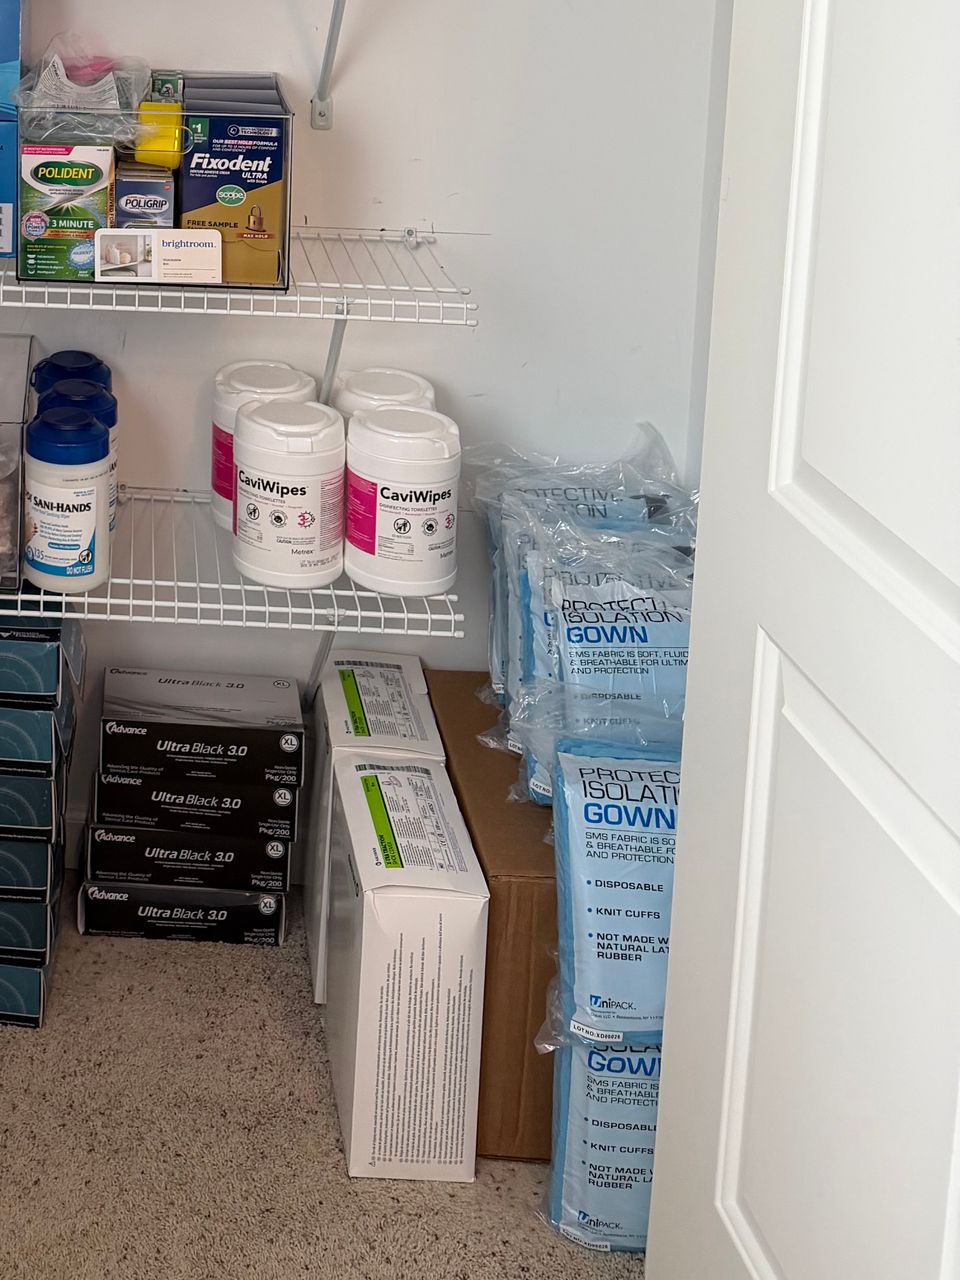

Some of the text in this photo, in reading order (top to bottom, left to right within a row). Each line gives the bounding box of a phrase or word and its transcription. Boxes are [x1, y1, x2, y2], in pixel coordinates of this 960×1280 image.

[190, 153, 272, 171] Fixodent
[38, 166, 95, 179] POLIDENT
[124, 198, 167, 210] POLIGRIP
[58, 220, 94, 229] MINUTE
[208, 220, 239, 229] SAMPLE
[162, 239, 213, 249] brightroom
[238, 470, 307, 498] CaviWipes
[380, 487, 452, 505] CaviWipes
[33, 497, 92, 513] SANI-HANDS
[562, 610, 683, 624] ISOLATION
[566, 625, 649, 644] GOWN
[594, 667, 649, 675] PROTECTION
[106, 721, 148, 735] Advance
[156, 740, 248, 756] Ultra Black 3.0
[102, 774, 143, 786] Advance
[151, 791, 242, 809] Ultra Black 3.0
[584, 803, 675, 829] GOWN
[94, 829, 136, 843] Advance
[585, 832, 648, 844] SMS FABRIC
[597, 842, 663, 854] BREATHABLE
[144, 847, 234, 863] Ultra Black 3.0
[586, 851, 674, 864] AND PROTECTION
[595, 879, 664, 892] DISPOSABLE
[596, 907, 661, 919] KNIT CUFFS
[597, 933, 654, 944] NOT MADE
[597, 942, 649, 953] NATURAL
[597, 952, 642, 962] RUBBER
[590, 1143, 654, 1155] KNIT CUFFS
